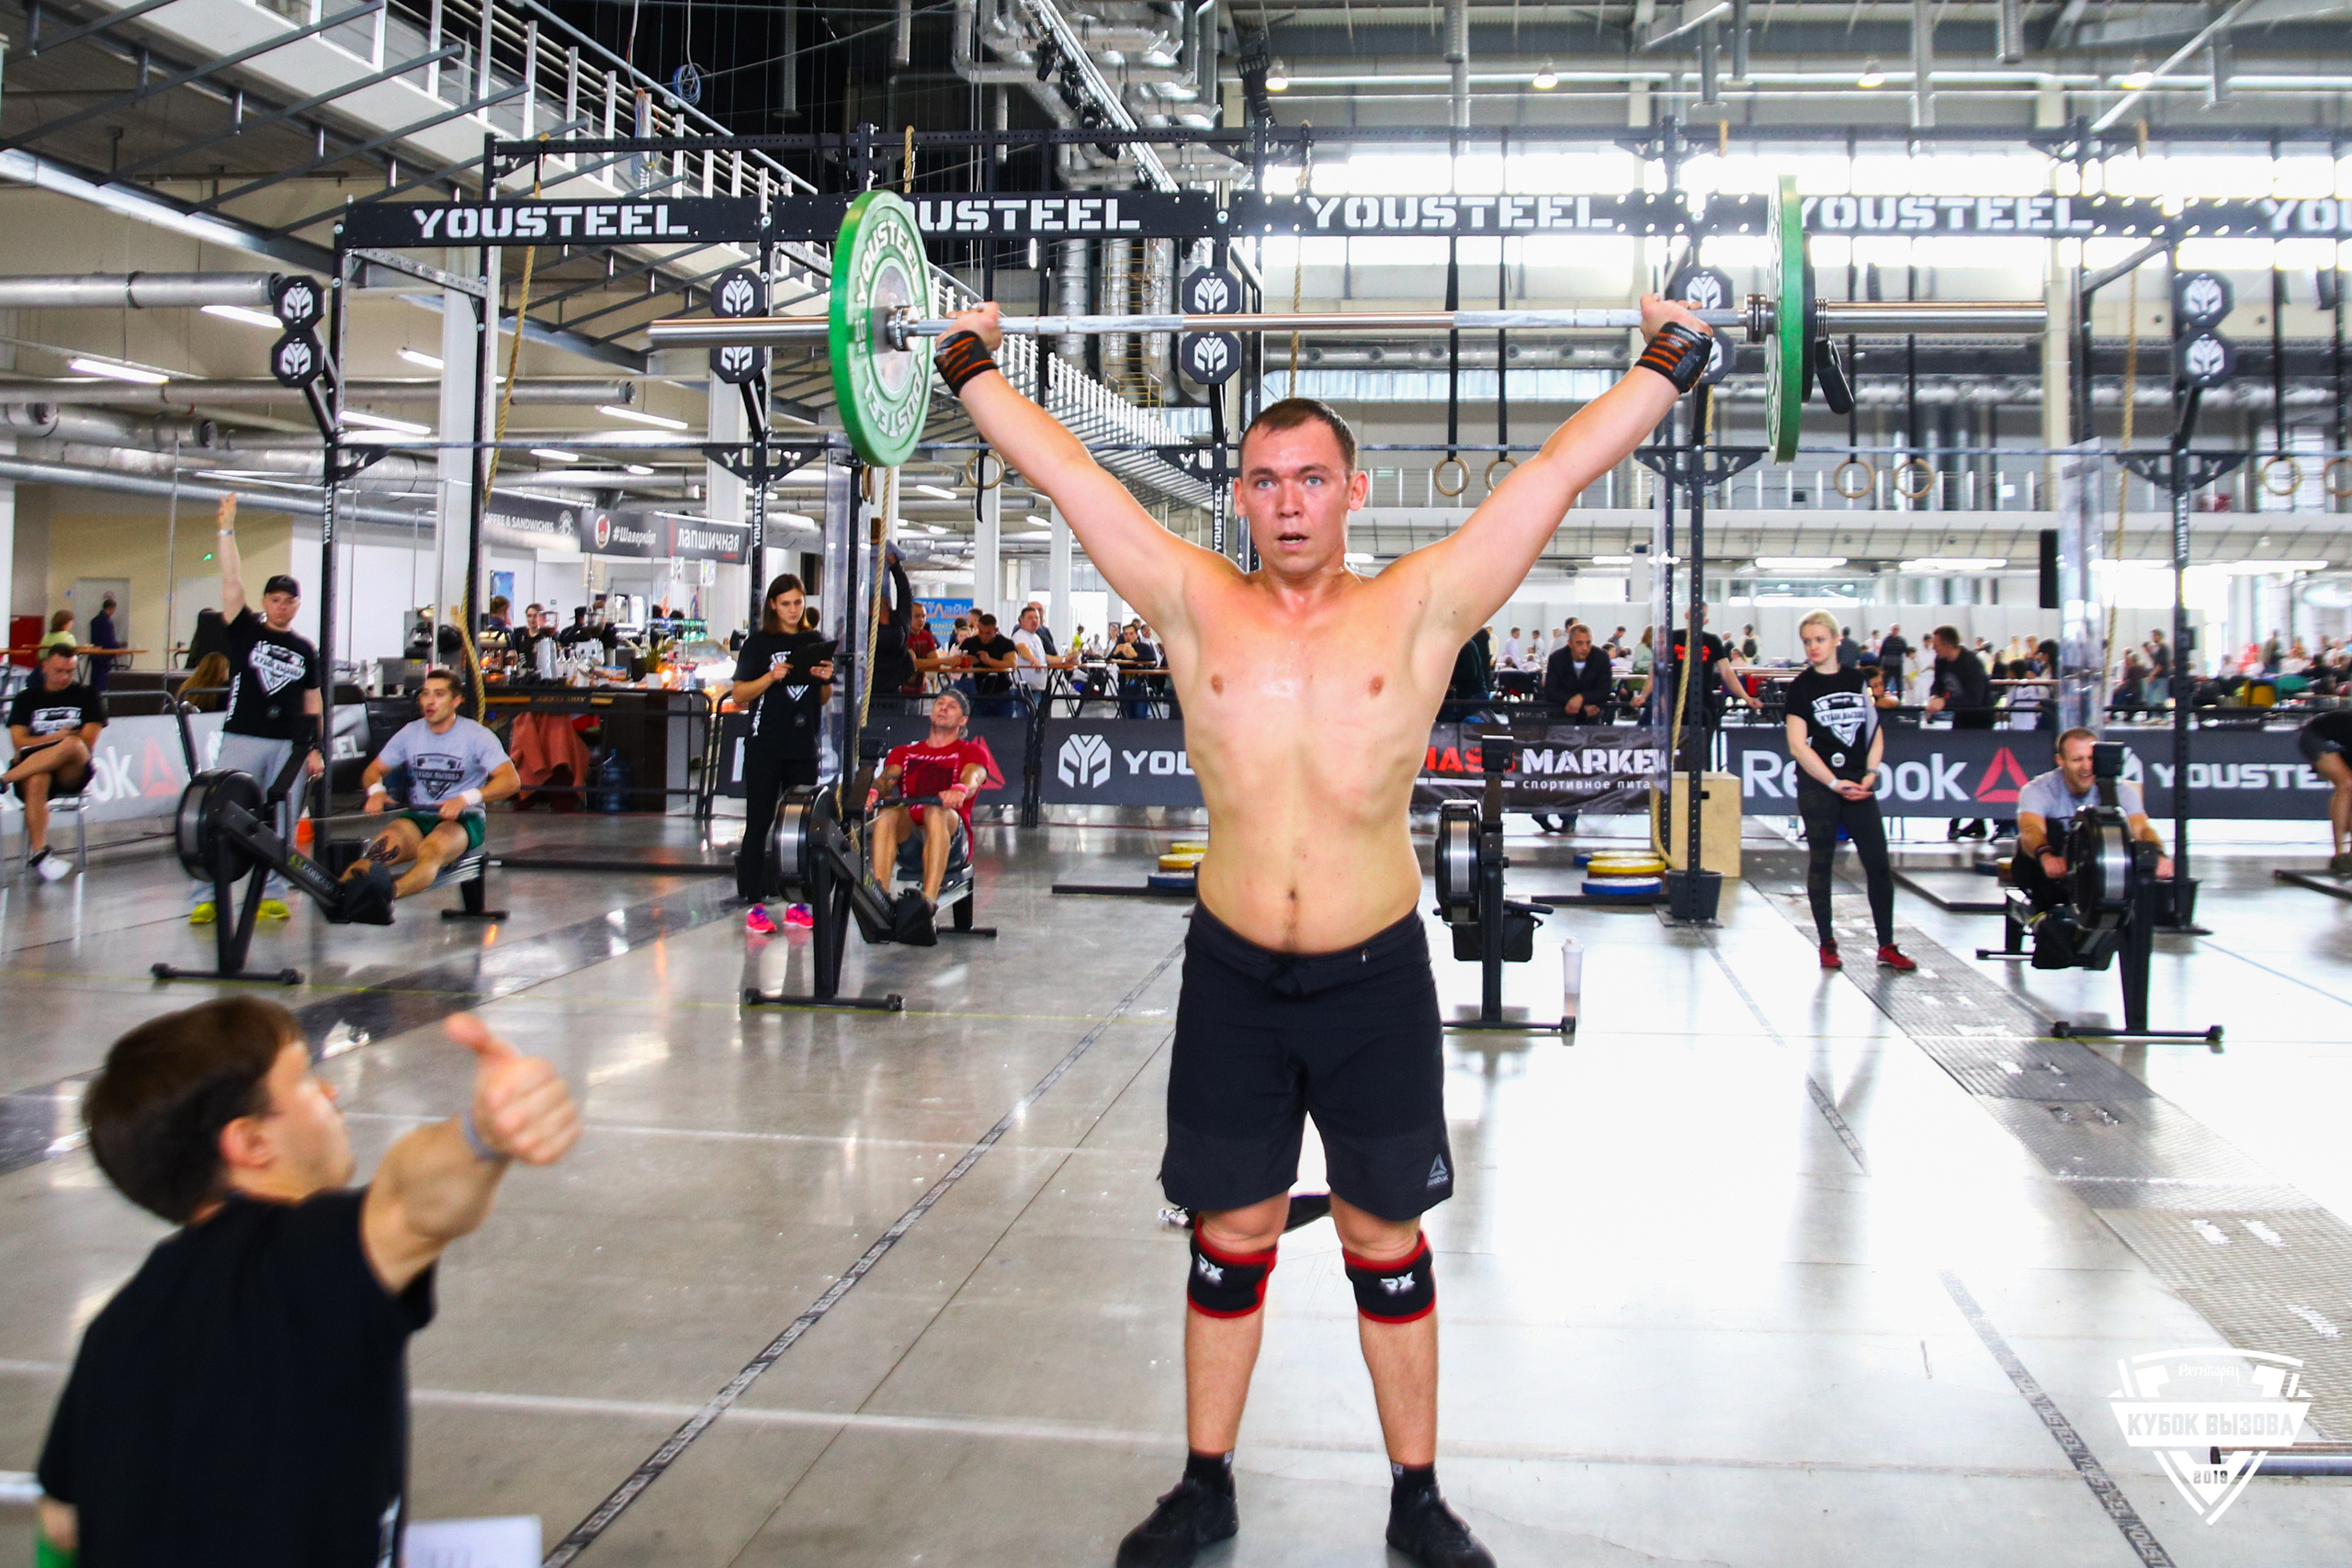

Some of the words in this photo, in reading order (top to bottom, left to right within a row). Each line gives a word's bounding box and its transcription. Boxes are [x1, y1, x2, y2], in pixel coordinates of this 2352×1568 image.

[414, 205, 689, 239] YOUSTEEL
[904, 197, 1140, 232] USTEEL
[1306, 196, 1613, 230] YOUSTEEL
[856, 220, 920, 303] YOUSTEEL
[865, 351, 927, 437] YOUSTEEL
[322, 482, 334, 545] YOUSTEEL
[484, 512, 506, 526] OFFEE
[512, 516, 555, 533] SANDWICHES
[753, 482, 763, 548] YOUSTEEL
[1214, 484, 1223, 553] YOUSTEEL
[678, 527, 740, 552] лапшичная
[1522, 778, 1611, 791] спортивное
[1198, 1253, 1225, 1281] RX
[1380, 1271, 1417, 1292] RX
